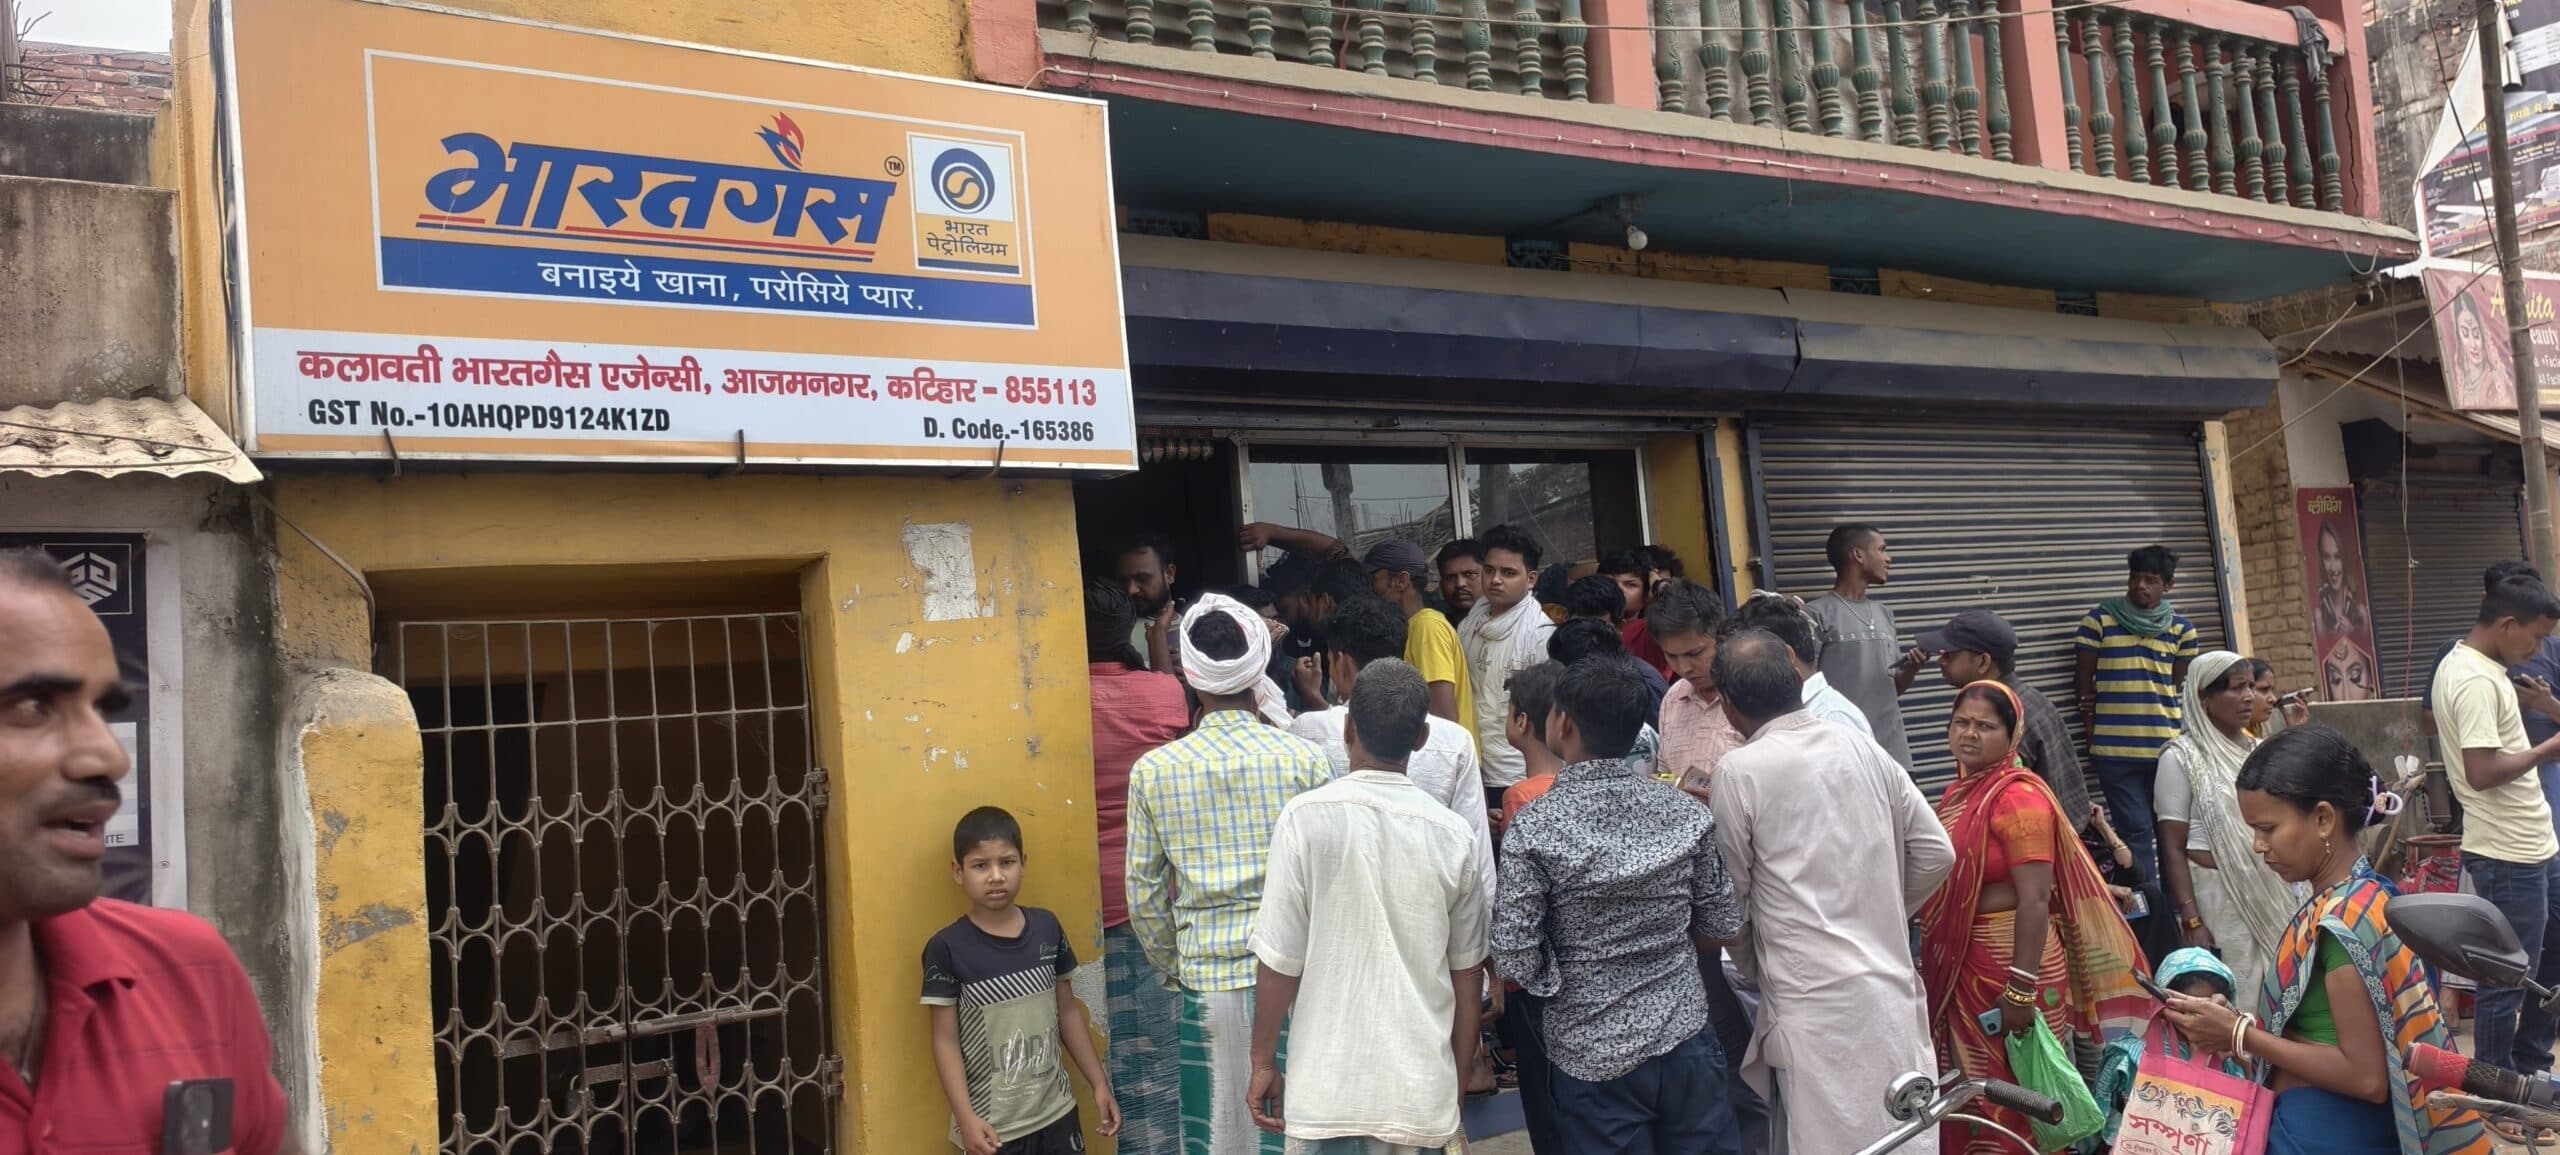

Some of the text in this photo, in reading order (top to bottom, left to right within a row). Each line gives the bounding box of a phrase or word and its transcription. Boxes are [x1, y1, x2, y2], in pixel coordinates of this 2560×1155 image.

[944, 219, 990, 237] भारत
[926, 231, 1008, 257] पेट्रोलियम
[537, 259, 642, 296] बनाइये
[749, 269, 850, 306] परोसिये
[2528, 326, 2560, 350] eauty
[296, 343, 443, 384] कलावती
[452, 349, 592, 390] भारतगैस
[599, 354, 712, 395] एजेन्सी,
[722, 368, 879, 402] आजमनगर,
[886, 366, 978, 405] कटिहार
[1005, 375, 1097, 406] 855113
[308, 398, 670, 432] GST No.-10AHQPD9124K1ZD
[924, 416, 1095, 442] D. Code.-165386
